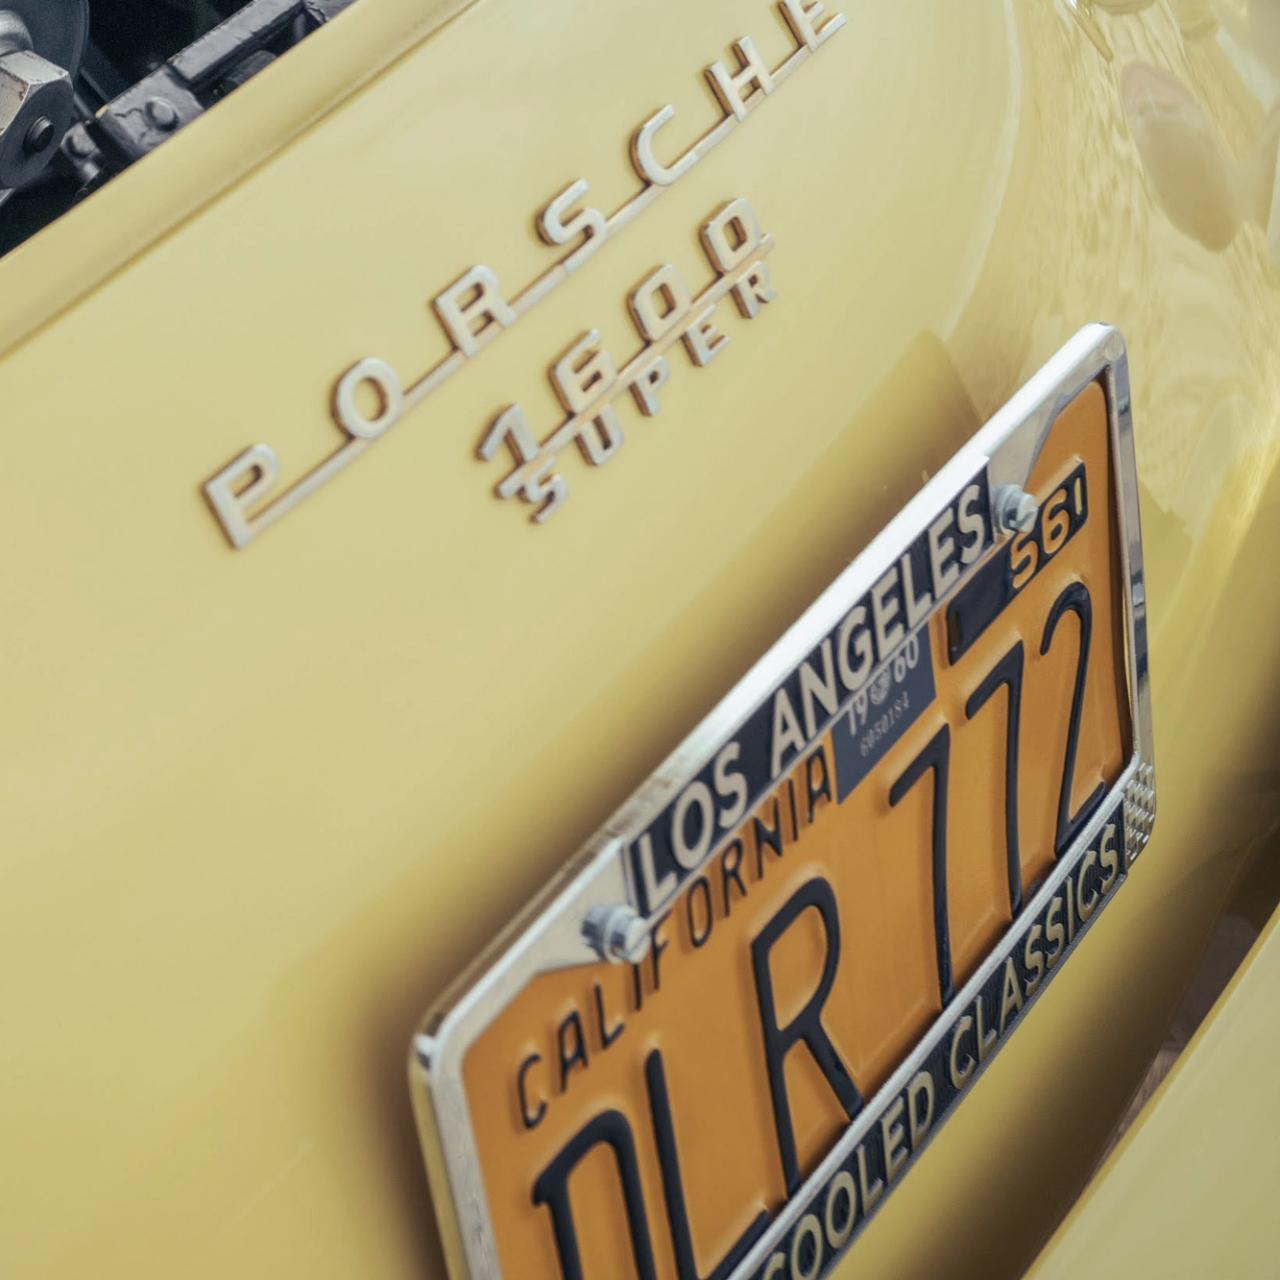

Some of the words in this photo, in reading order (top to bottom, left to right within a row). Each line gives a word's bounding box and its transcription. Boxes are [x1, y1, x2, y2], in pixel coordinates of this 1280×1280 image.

[477, 198, 773, 498] 1600
[518, 260, 778, 523] SUPER
[641, 742, 748, 911] LOS
[771, 484, 986, 780] ANGELES
[889, 582, 1106, 1010] 772
[518, 744, 832, 1130] CALIFORNIA
[949, 824, 1118, 1089] CLASSICS
